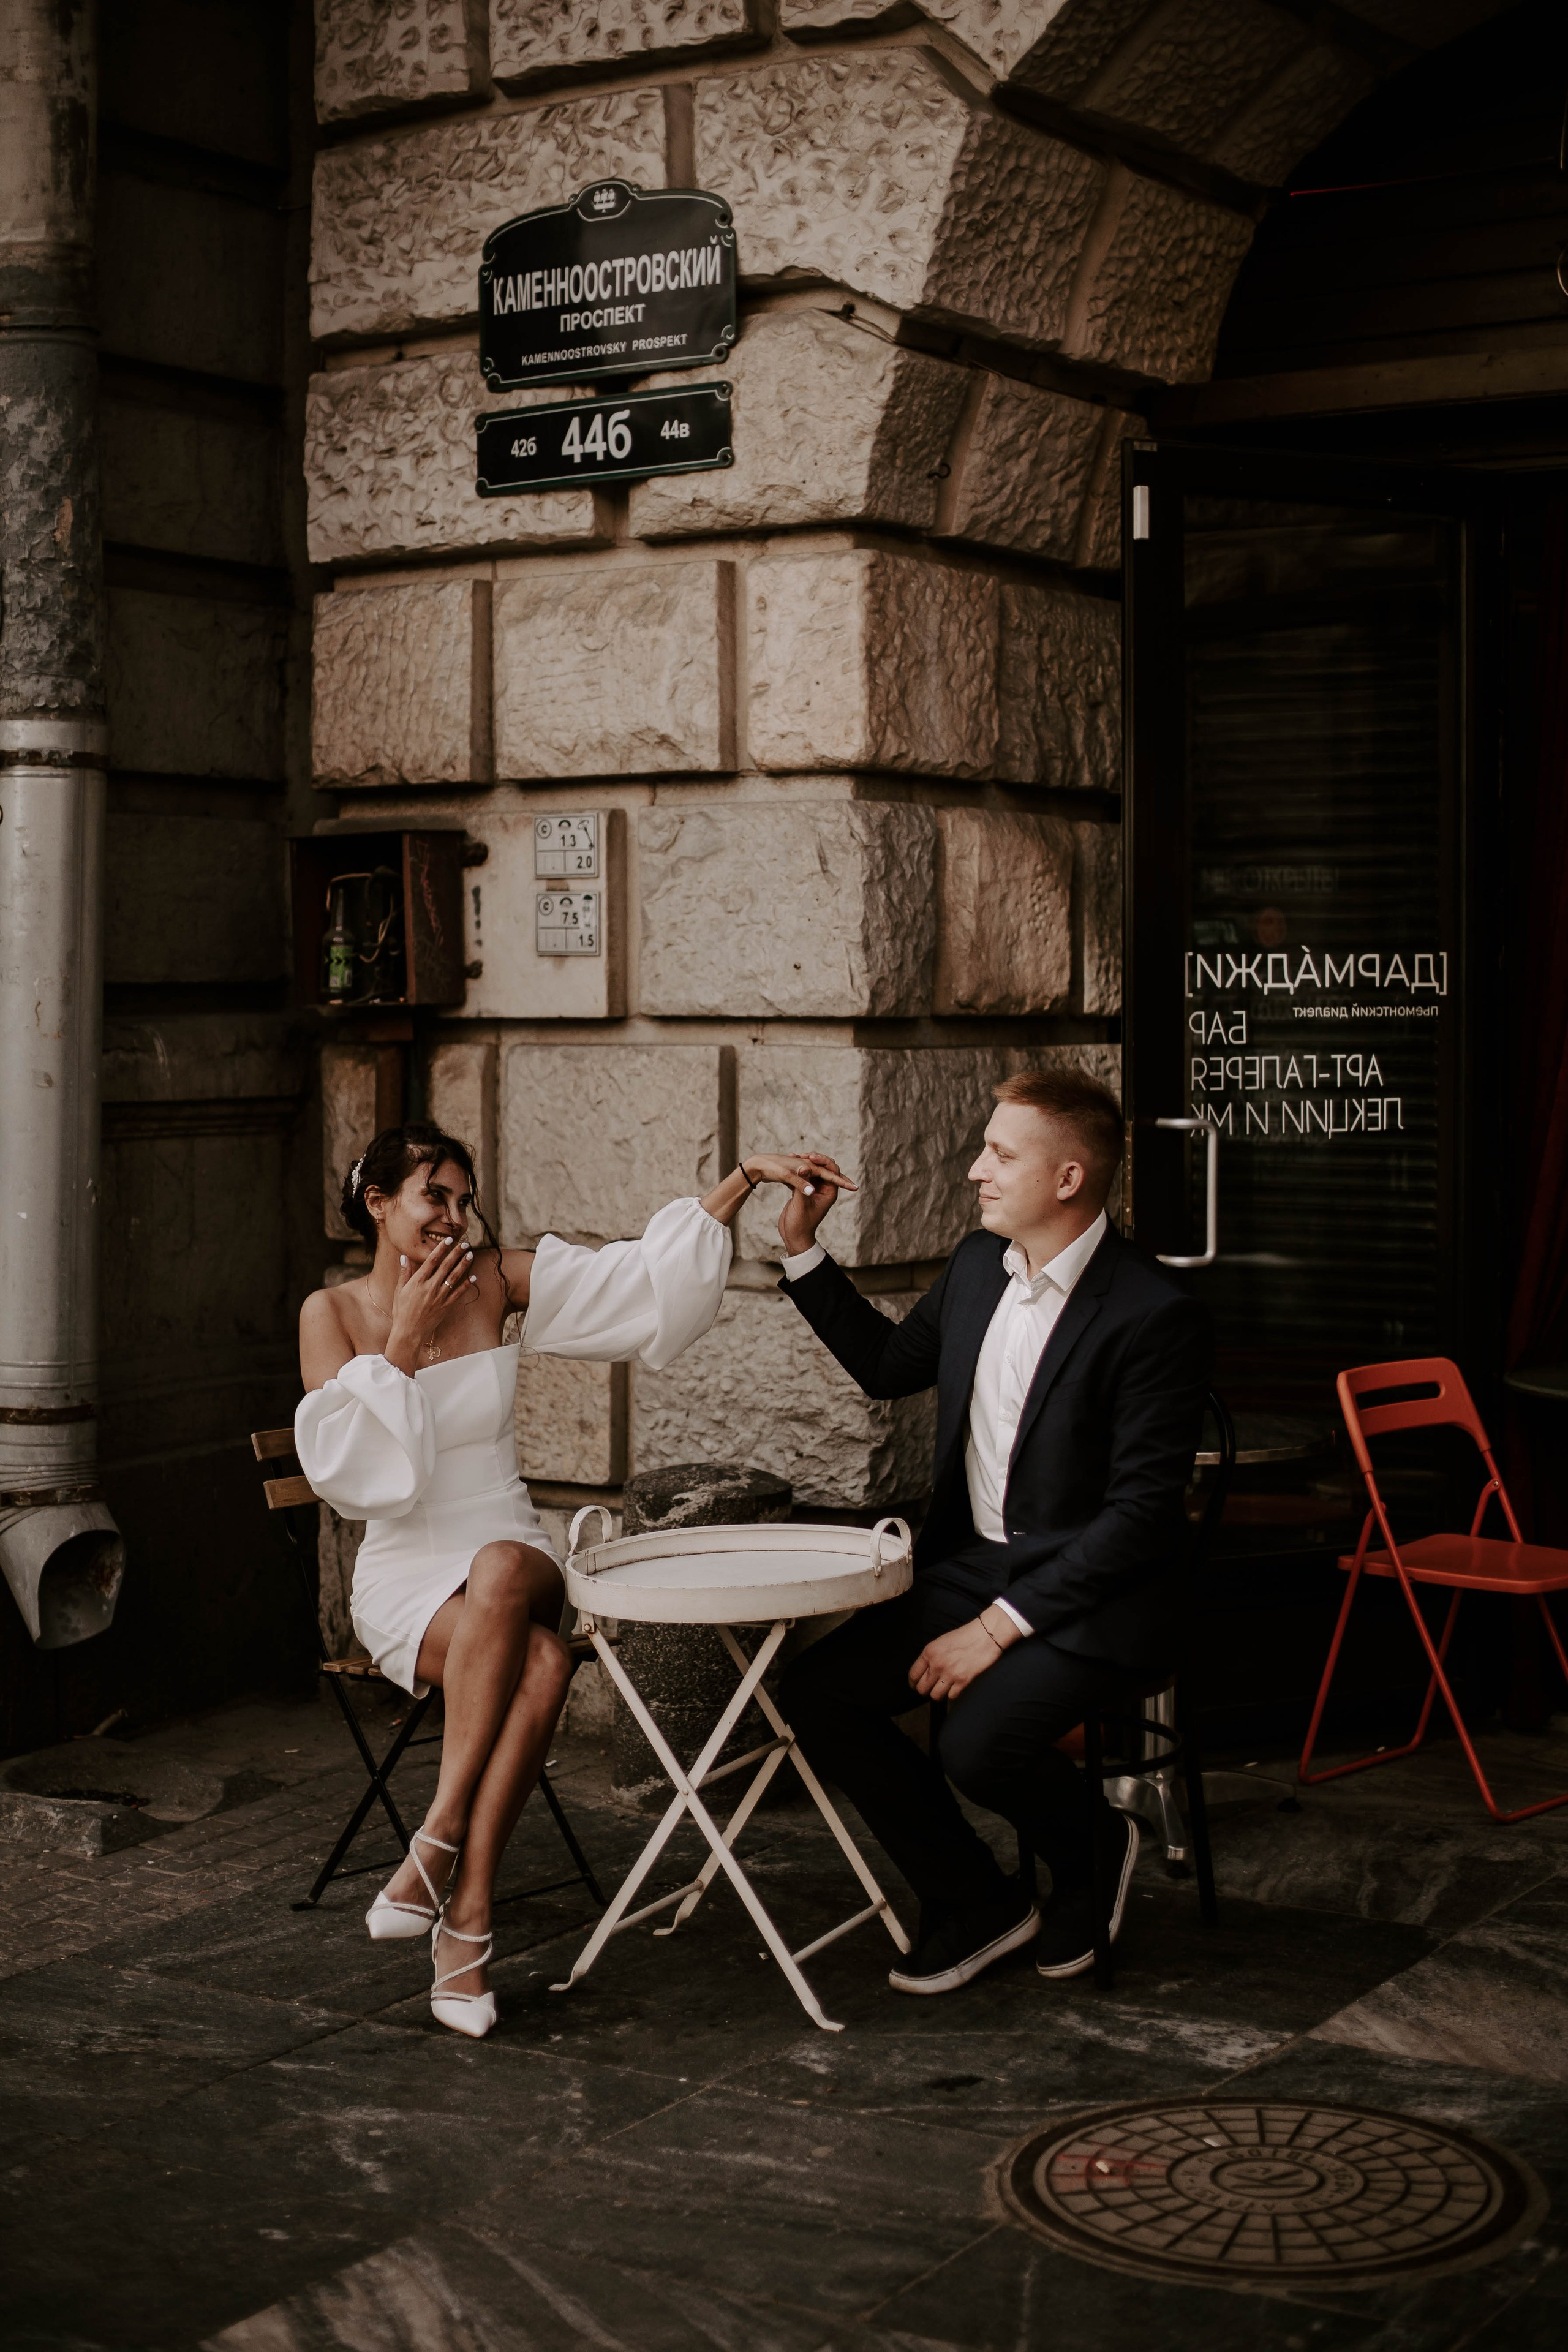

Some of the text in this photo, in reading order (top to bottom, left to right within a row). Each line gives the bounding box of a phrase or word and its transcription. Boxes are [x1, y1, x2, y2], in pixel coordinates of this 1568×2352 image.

[494, 235, 721, 315] КАМЕННООСТРОВСКИЙ
[560, 303, 646, 332] ПРОСПЕКТ
[521, 333, 688, 366] KAMENNOOSTROVSKY PROSPEKT
